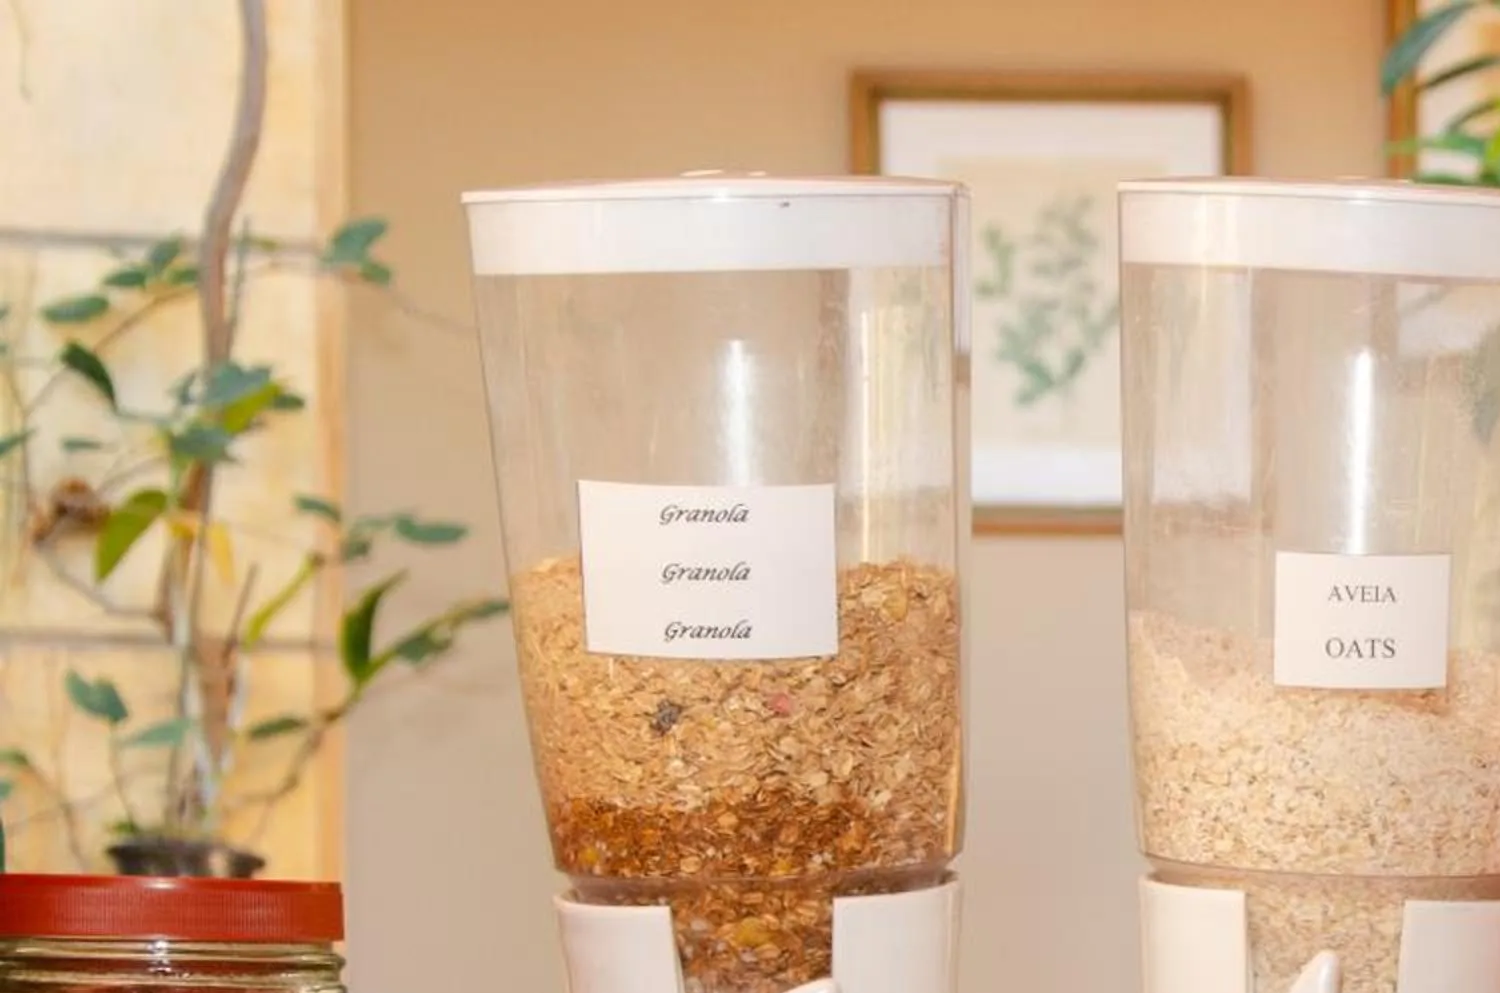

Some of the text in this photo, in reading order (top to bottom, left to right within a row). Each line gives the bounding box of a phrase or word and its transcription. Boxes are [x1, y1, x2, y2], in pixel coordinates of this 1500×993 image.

[659, 503, 750, 526] Granola
[661, 561, 751, 585] Granola
[1328, 585, 1398, 603] AVEIA
[663, 619, 753, 642] Granola
[1325, 637, 1396, 659] OATS
